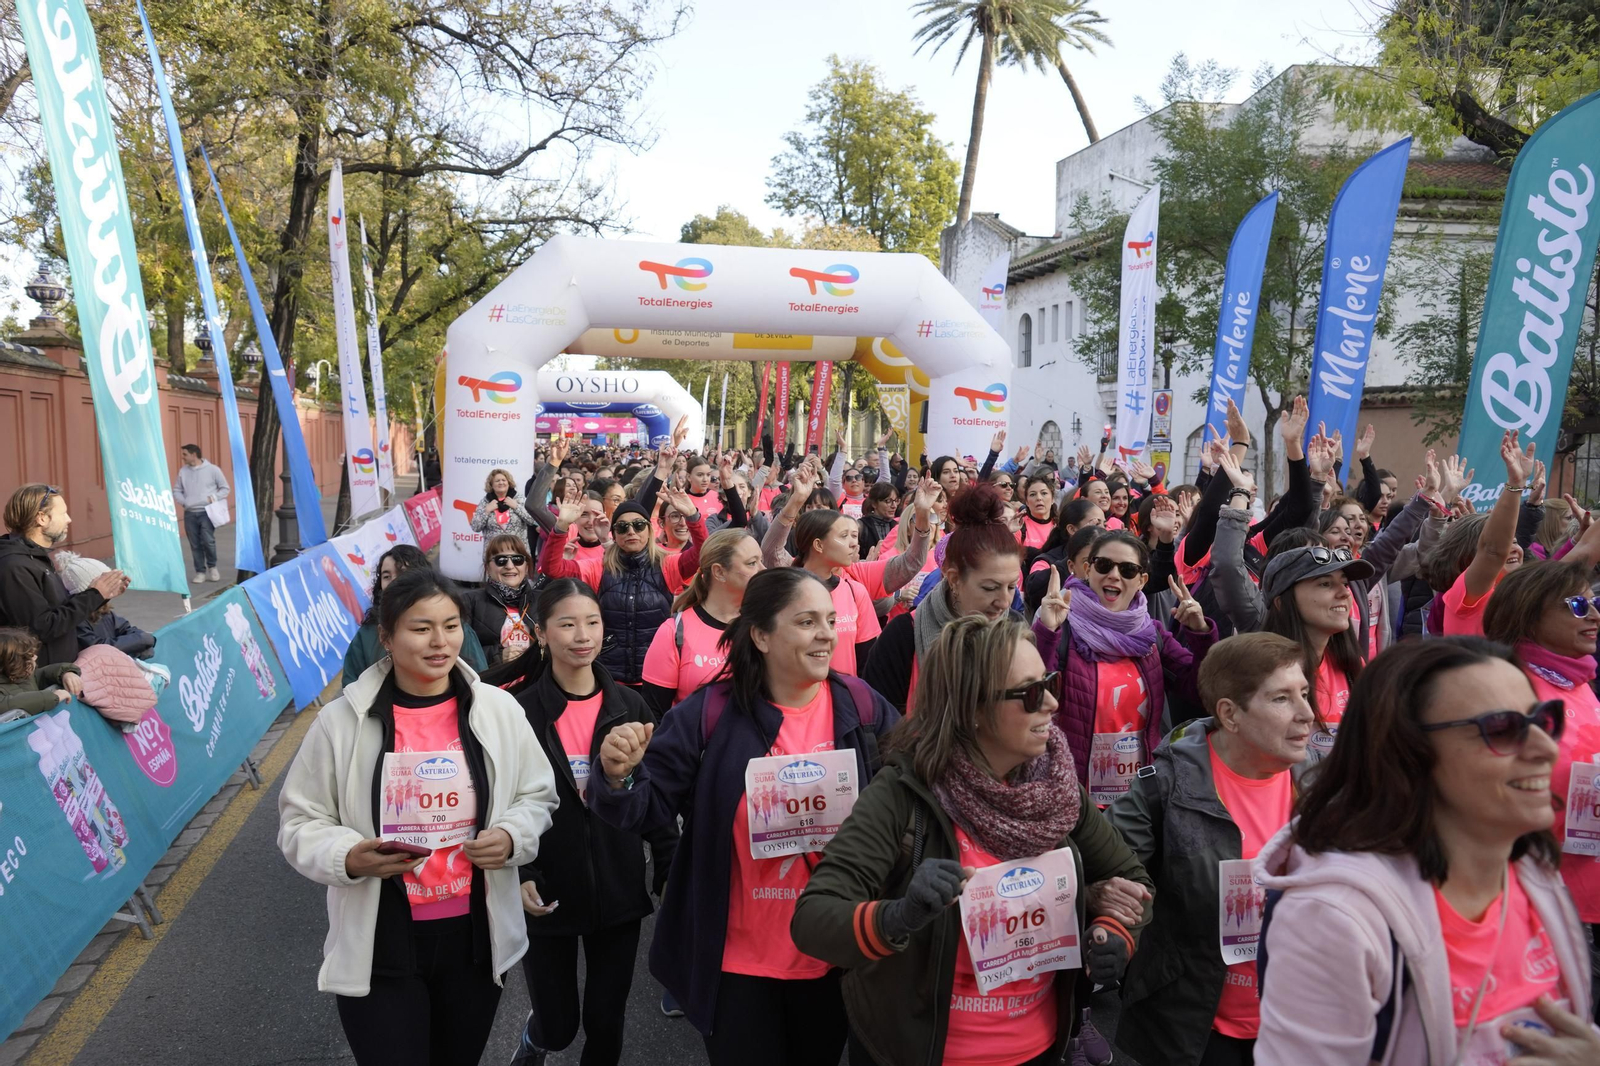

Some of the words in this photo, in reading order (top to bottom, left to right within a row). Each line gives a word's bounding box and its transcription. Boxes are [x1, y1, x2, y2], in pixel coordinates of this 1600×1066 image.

[638, 297, 713, 310] TotalEnergies
[1481, 163, 1595, 439] Batiste
[788, 302, 859, 315] TotalEnergies
[505, 313, 566, 327] LasCarreras
[1319, 255, 1379, 400] Marlene
[650, 329, 680, 338] Instituto
[684, 330, 722, 340] Municipal
[662, 338, 672, 346] de
[674, 338, 710, 348] Deportes
[1214, 291, 1251, 414] Marlene
[556, 376, 639, 394] OYSHO
[813, 360, 829, 416] Santander
[456, 409, 521, 421] TotalEnergies
[952, 417, 1007, 429] TotalEnergies
[454, 456, 519, 466] totalenergies.es
[270, 565, 352, 687] Marlene
[509, 632, 529, 642] 016
[178, 632, 222, 733] Batiste
[147, 747, 173, 773] ESPAÑA
[782, 770, 823, 780] ASTURIANA
[418, 791, 459, 809] 016
[786, 795, 827, 814] 016
[432, 814, 446, 822] 700
[799, 818, 814, 827] 618
[436, 823, 453, 831] MUJER
[766, 831, 789, 839] CARRERA
[804, 827, 822, 835] MUJER
[393, 836, 428, 844] OYSHO
[447, 830, 471, 842] Santander
[763, 840, 797, 853] OYSHO
[1572, 841, 1596, 850] OYSHO
[435, 884, 448, 895] DE
[1000, 877, 1042, 894] ASTURIANA
[752, 886, 797, 900] CARRERA
[970, 889, 995, 901] SUMA
[1005, 908, 1046, 935] 016
[1014, 936, 1035, 948] 1560
[982, 957, 1007, 969] CARRERA
[1021, 946, 1039, 957] MUJER
[1042, 940, 1061, 951] SEVILLA
[1033, 954, 1067, 969] Santander
[950, 994, 1005, 1013] CARRERA
[1007, 996, 1022, 1010] DE
